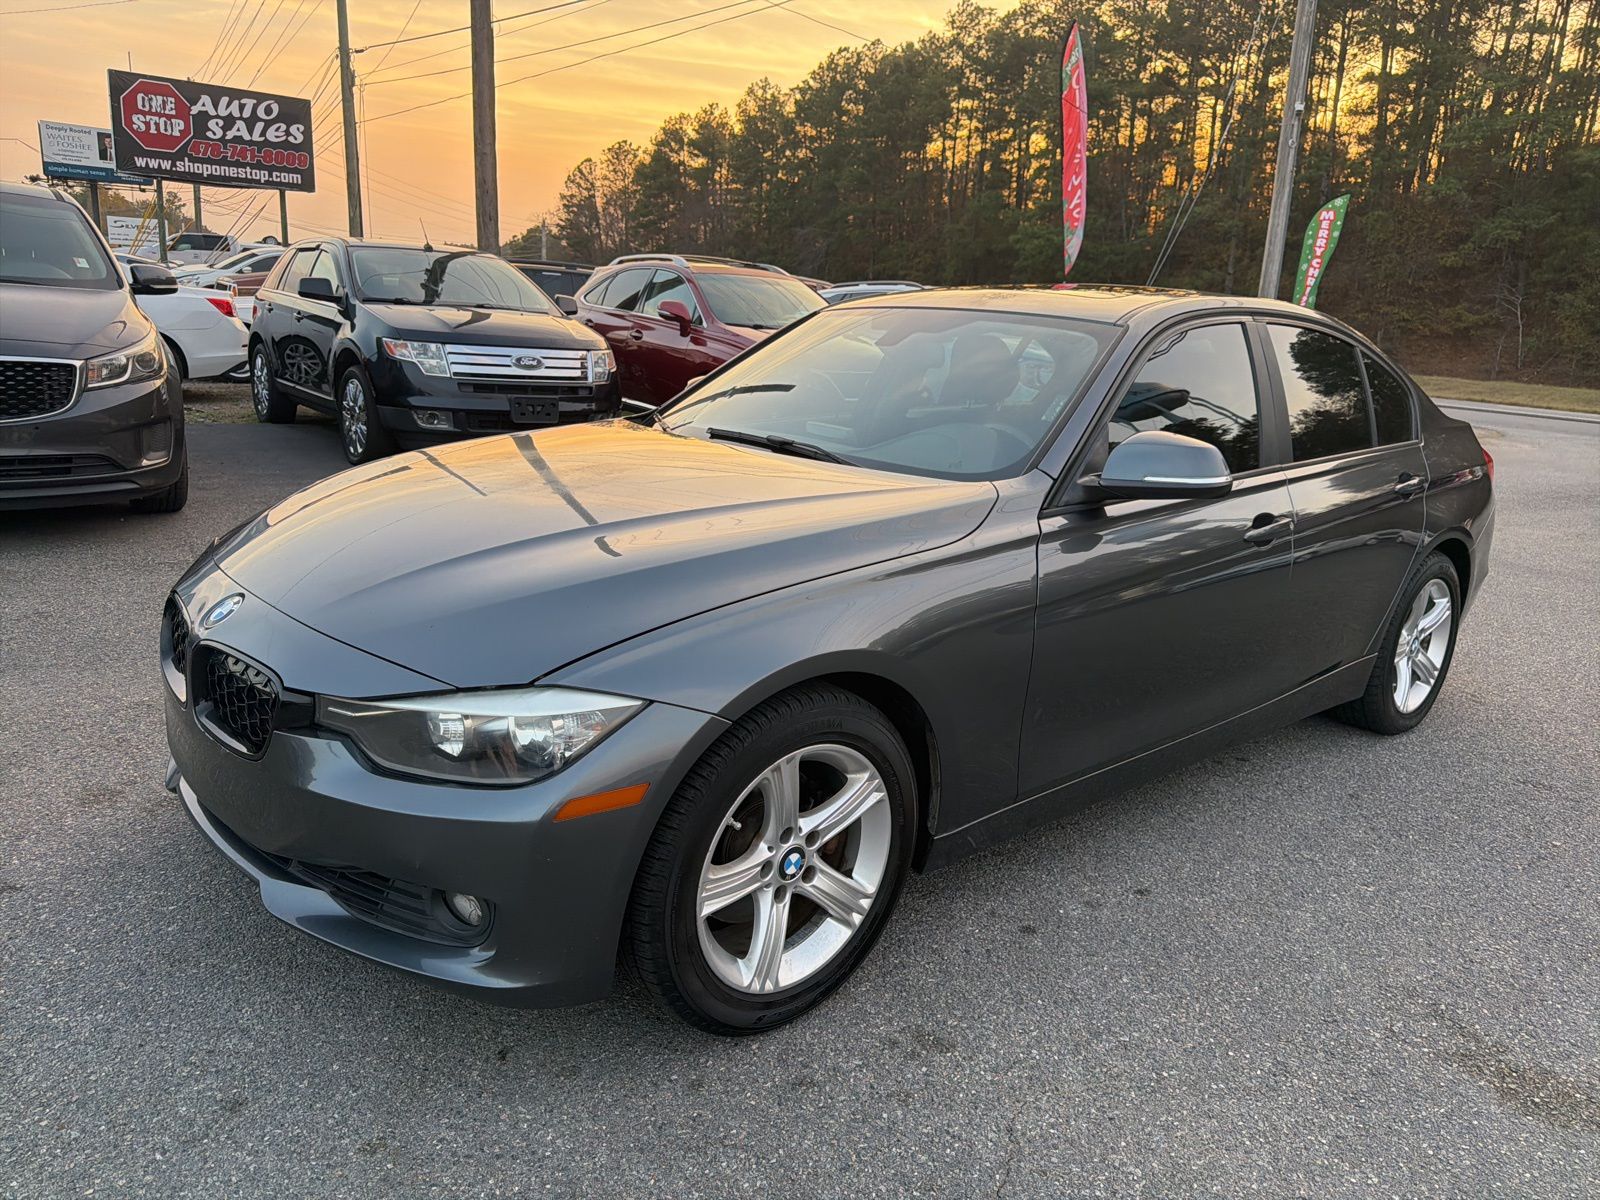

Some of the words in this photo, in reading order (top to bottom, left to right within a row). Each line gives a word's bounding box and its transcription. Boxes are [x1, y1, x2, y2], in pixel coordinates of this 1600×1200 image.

[137, 93, 176, 115] ONE
[190, 95, 279, 120] AUTO
[45, 123, 68, 133] Deeply
[69, 126, 92, 135] Rooted
[132, 114, 185, 136] STOP
[206, 118, 304, 144] SALES
[46, 132, 83, 143] WAITES
[57, 140, 93, 151] FOSHEE
[48, 166, 68, 174] simple
[69, 166, 89, 175] human
[134, 156, 301, 184] www.shoponestop.com
[1315, 211, 1335, 257] MERRY
[520, 357, 538, 366] Ford
